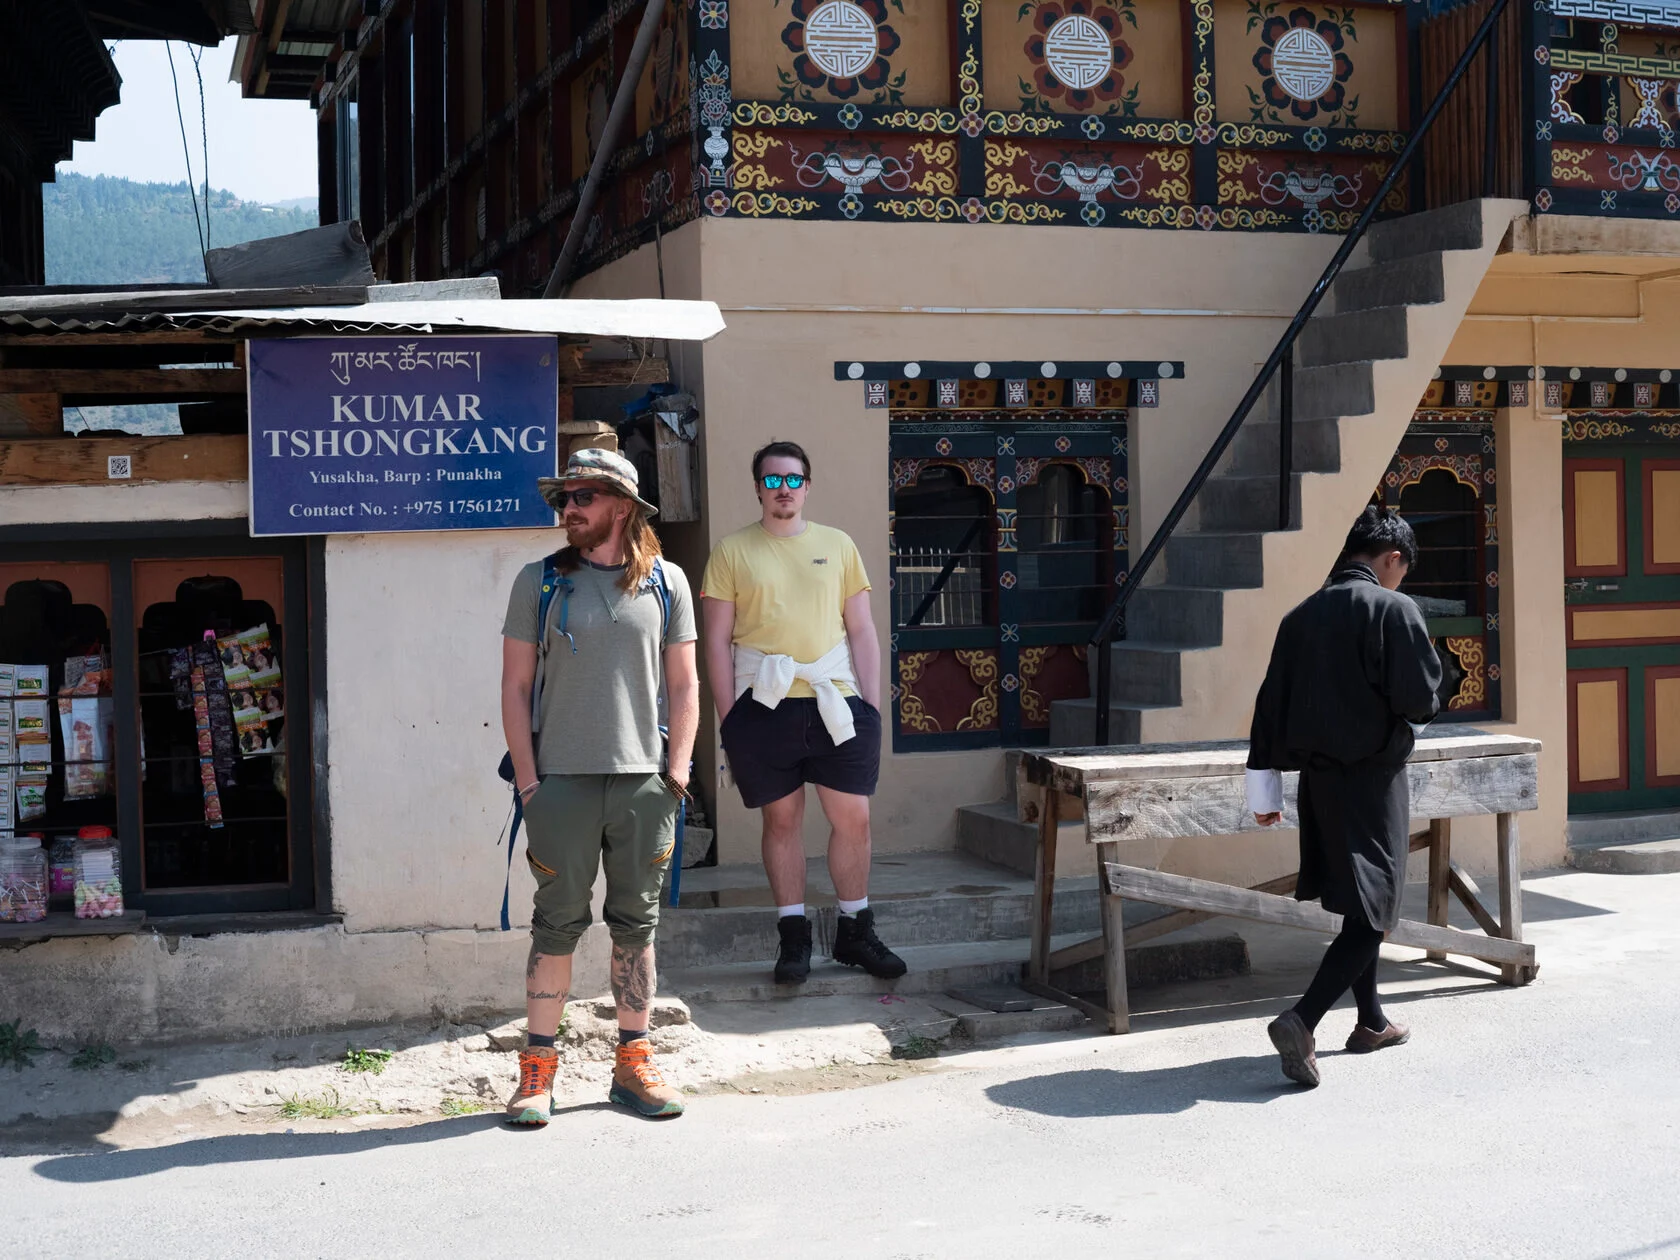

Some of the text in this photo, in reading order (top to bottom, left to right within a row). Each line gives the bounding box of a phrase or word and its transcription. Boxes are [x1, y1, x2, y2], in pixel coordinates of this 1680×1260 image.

[331, 393, 484, 423] KUMAR
[262, 425, 548, 458] TSHONGKANG
[309, 470, 379, 484] Yusakha,
[384, 470, 421, 486] Barp
[436, 467, 502, 482] Punakha
[289, 503, 354, 518] Contact
[359, 502, 388, 516] No.
[403, 500, 442, 514] +975
[448, 498, 520, 514] 17561271
